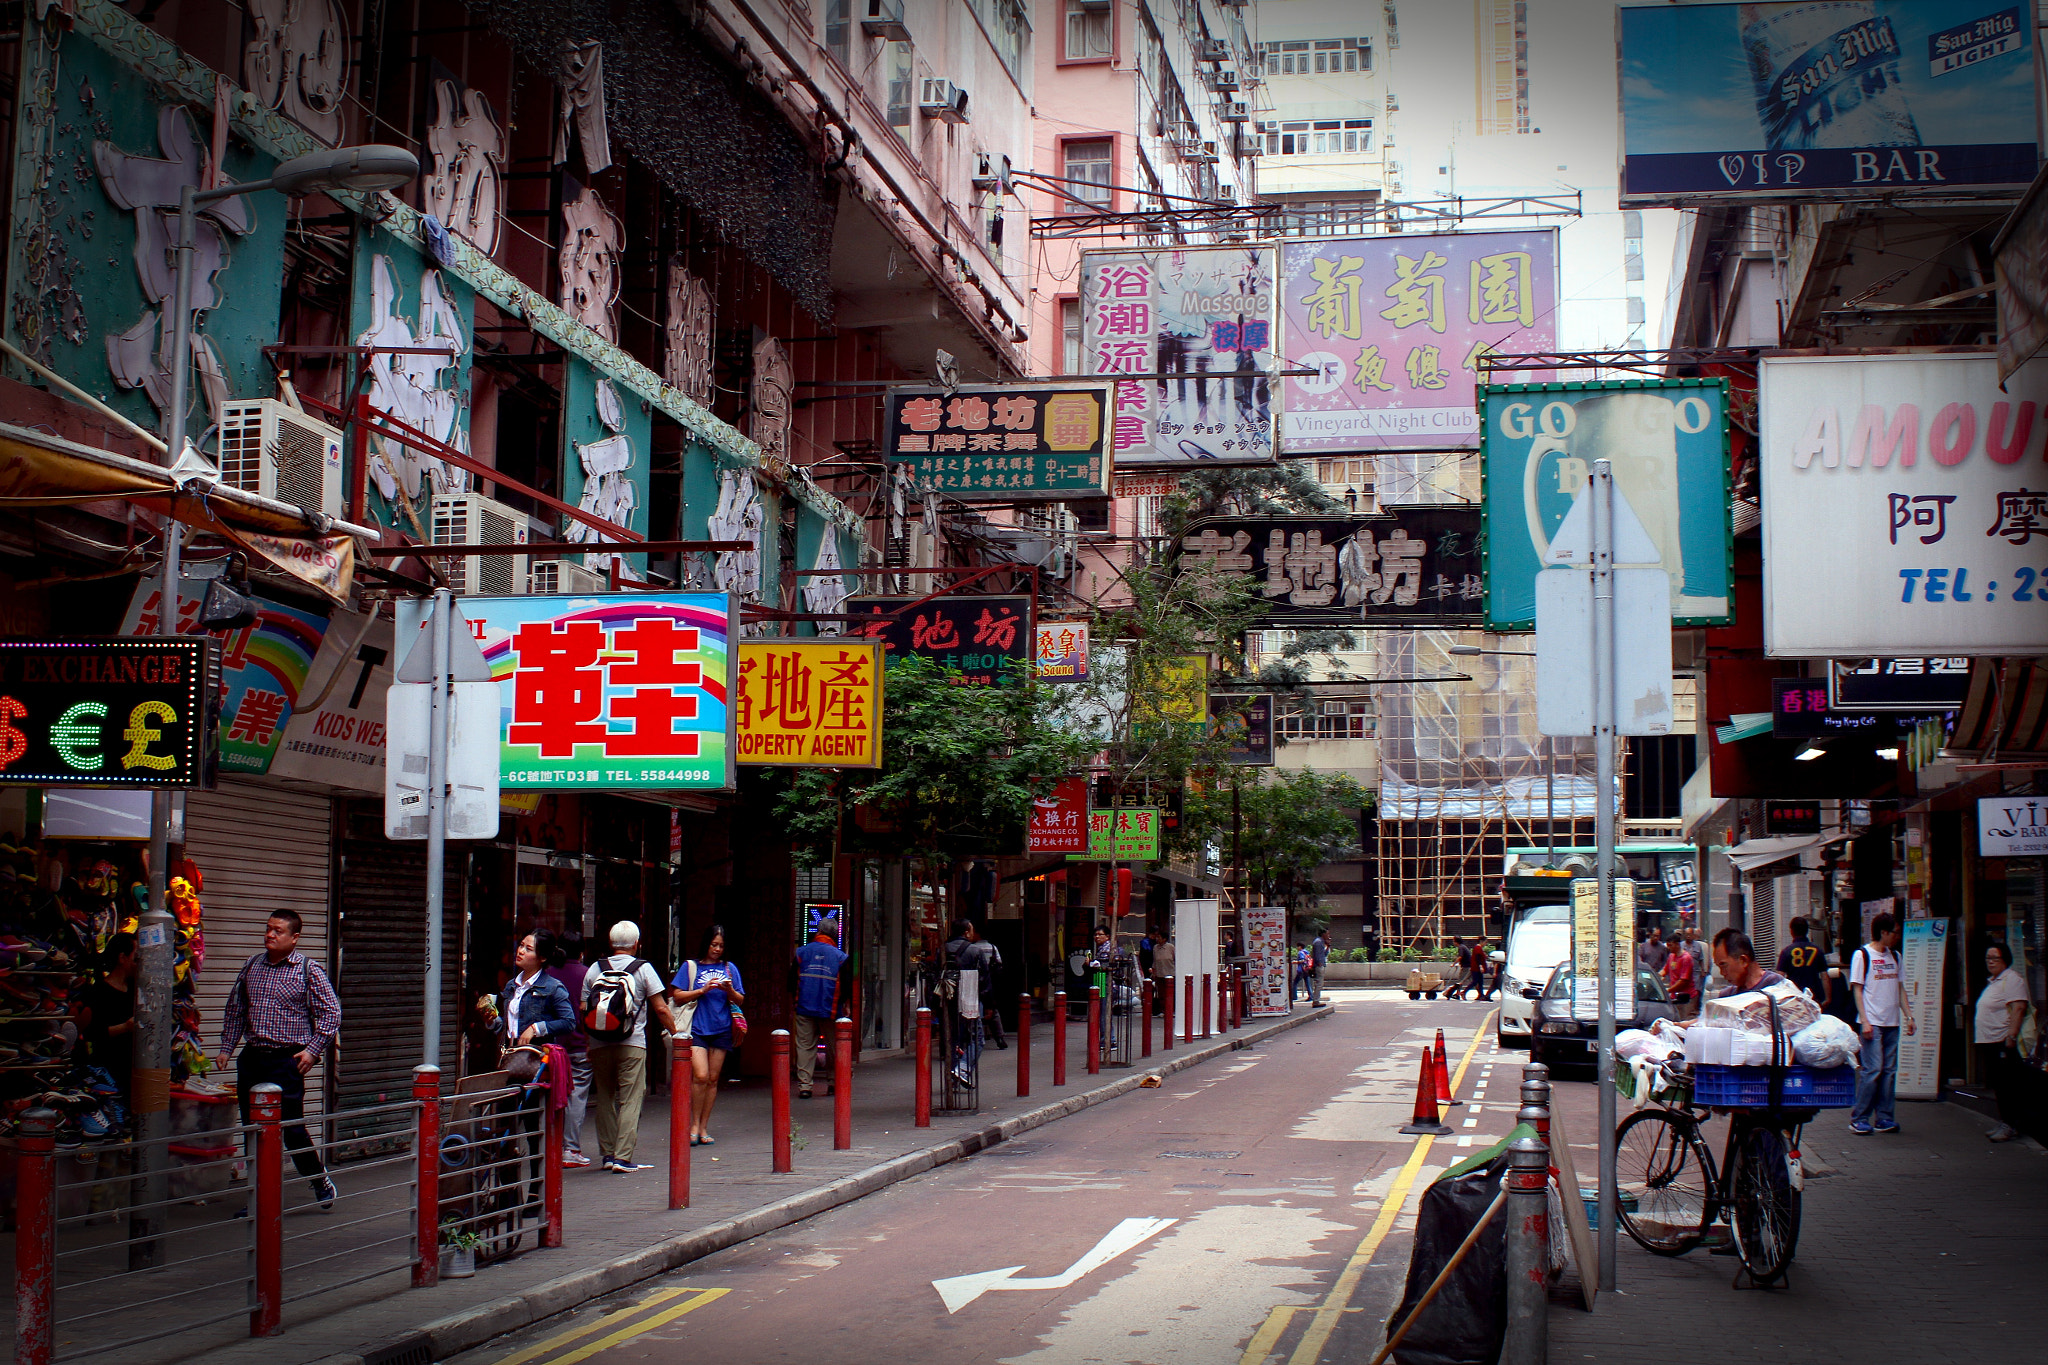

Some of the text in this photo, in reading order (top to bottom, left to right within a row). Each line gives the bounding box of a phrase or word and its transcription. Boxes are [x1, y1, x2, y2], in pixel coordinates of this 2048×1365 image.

[1935, 13, 2015, 55] San Mig
[1944, 37, 2010, 71] LIGHT
[1717, 150, 1946, 186] VIP BAR
[1182, 290, 1269, 317] Massage
[1301, 251, 1535, 340] 葡萄園
[1213, 320, 1269, 353] 按摩
[900, 396, 1037, 432] 老地坊
[1296, 411, 1472, 435] Vineyard Night Club
[1500, 401, 1577, 439] GO
[898, 433, 1038, 452] 皇牌茶舞
[1793, 400, 2048, 470] AMOU
[22, 655, 181, 684] EXCHANGE
[1043, 663, 1075, 677] Sauna
[508, 618, 703, 760] 鞋
[1782, 689, 1827, 713] 香港
[313, 710, 356, 741] KIDS
[1825, 716, 1842, 728] Hong
[1844, 716, 1859, 728] Kong
[811, 734, 867, 757] AGENT
[2020, 826, 2047, 838] BAR
[1790, 946, 1818, 968] 87
